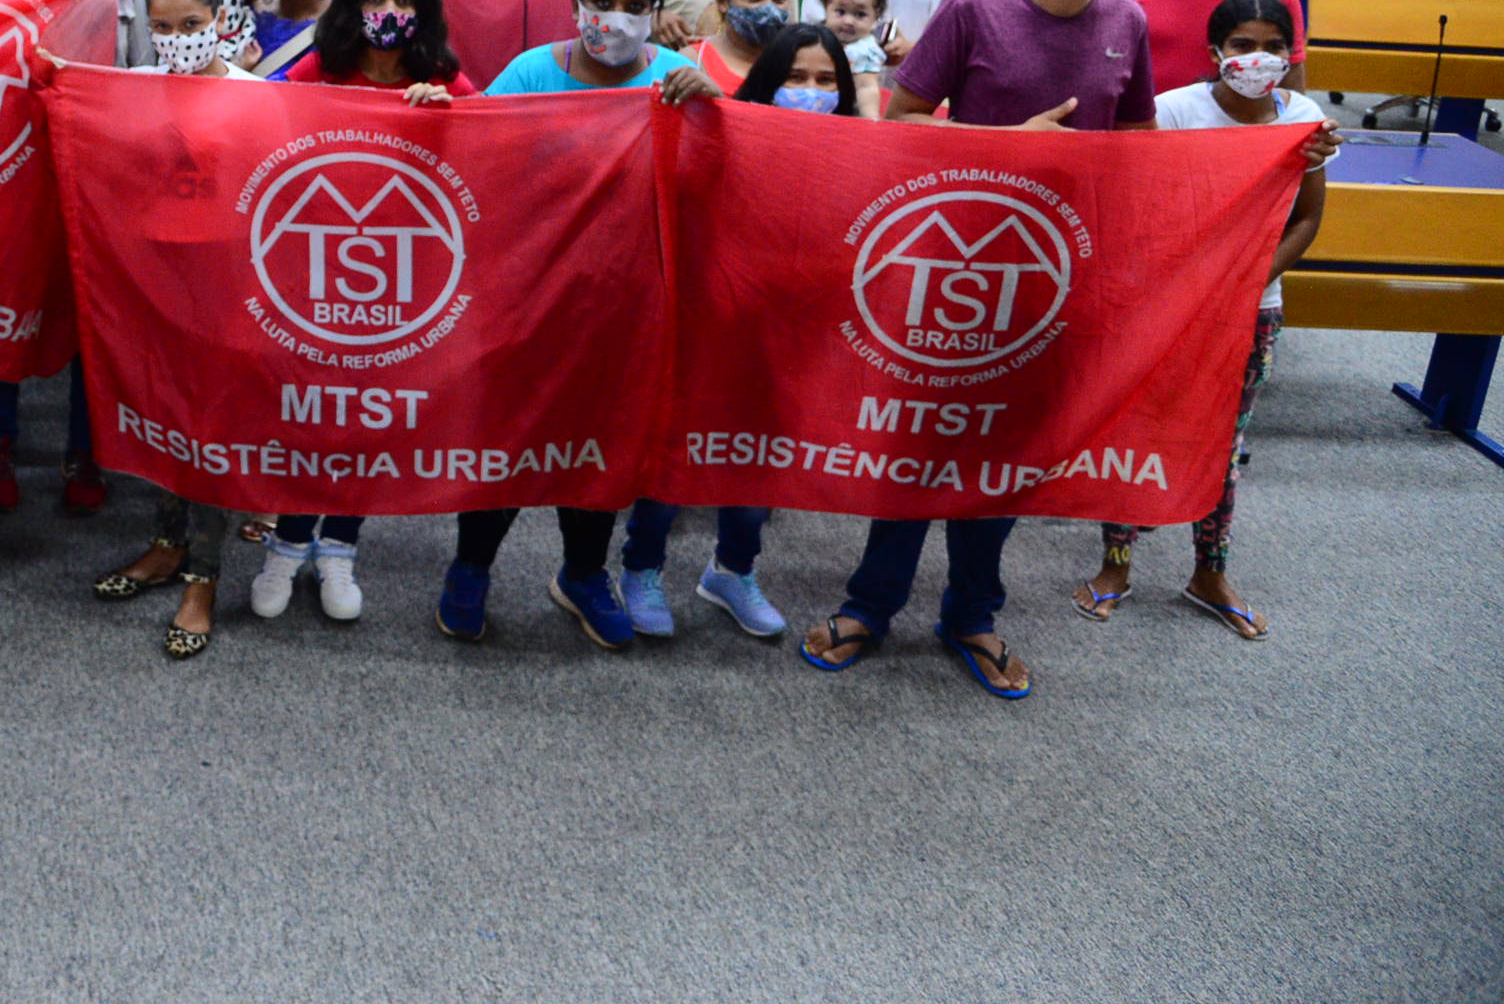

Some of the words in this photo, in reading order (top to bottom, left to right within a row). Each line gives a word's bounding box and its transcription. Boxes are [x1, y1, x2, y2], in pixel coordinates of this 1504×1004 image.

[235, 146, 289, 215] MOVIMENTO
[286, 134, 316, 156] DOS
[317, 129, 438, 166] TRABALHADORES
[435, 161, 463, 190] SEM
[457, 187, 481, 223] TETO
[843, 184, 907, 246] MOVIMENTO
[905, 172, 938, 192] DOS
[940, 168, 1061, 206] TRABALHADORES
[1056, 202, 1082, 229] SEM
[1073, 222, 1093, 259] TETO
[244, 296, 265, 322] NA
[260, 317, 296, 352] LUTA
[297, 342, 339, 368] PELA
[342, 342, 423, 370] REFORMA
[419, 294, 473, 349] URBANA
[313, 302, 409, 327] BRASIL
[905, 328, 1001, 352] BRASIL
[838, 319, 858, 343] NA
[851, 338, 885, 369] LUTA
[883, 362, 924, 387] PELA
[928, 365, 1010, 388] REFORMA
[1009, 320, 1069, 369] URBANA
[280, 383, 430, 430] MTST
[856, 396, 1008, 436] MTST
[412, 437, 607, 483] URBANA
[686, 431, 964, 492] RESISTÊNCIA
